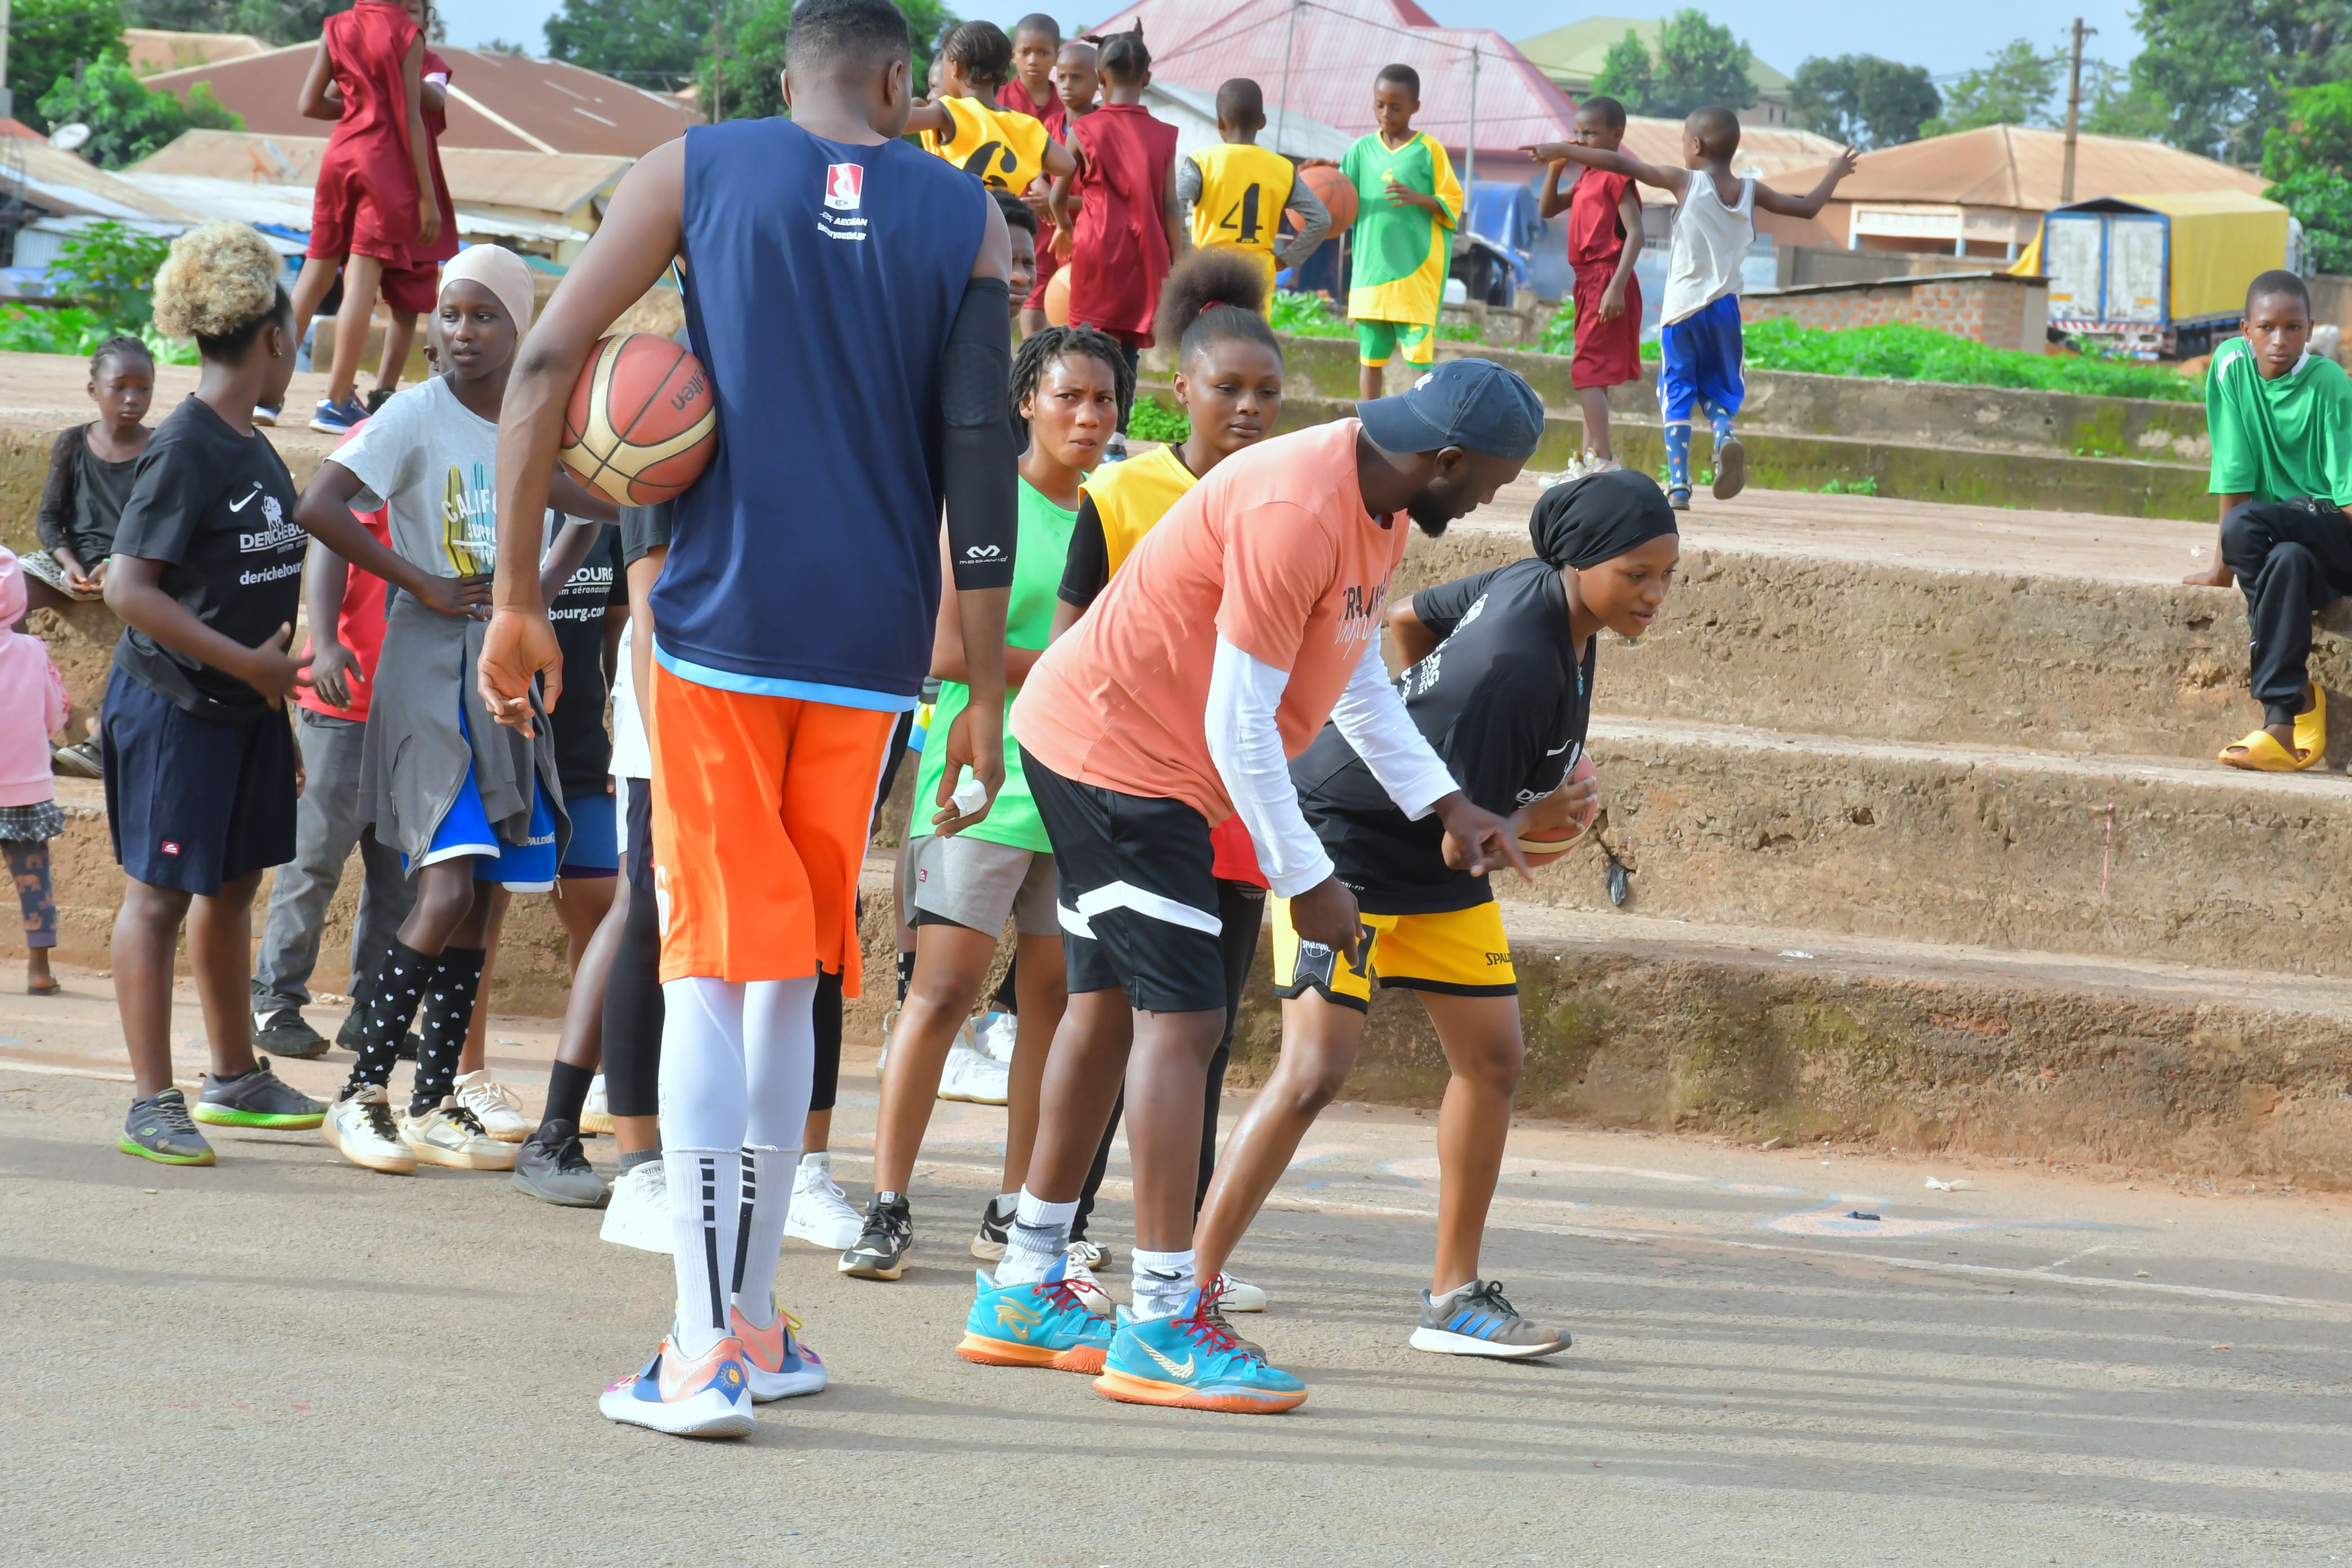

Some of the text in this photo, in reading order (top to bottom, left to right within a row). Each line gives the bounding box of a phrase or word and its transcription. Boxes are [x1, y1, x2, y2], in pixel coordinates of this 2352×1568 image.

[833, 217, 868, 226] AEGEAN
[1219, 182, 1263, 243] 4
[468, 523, 497, 542] SUPPL
[239, 562, 304, 585] derichebour
[517, 831, 555, 846] PALDING
